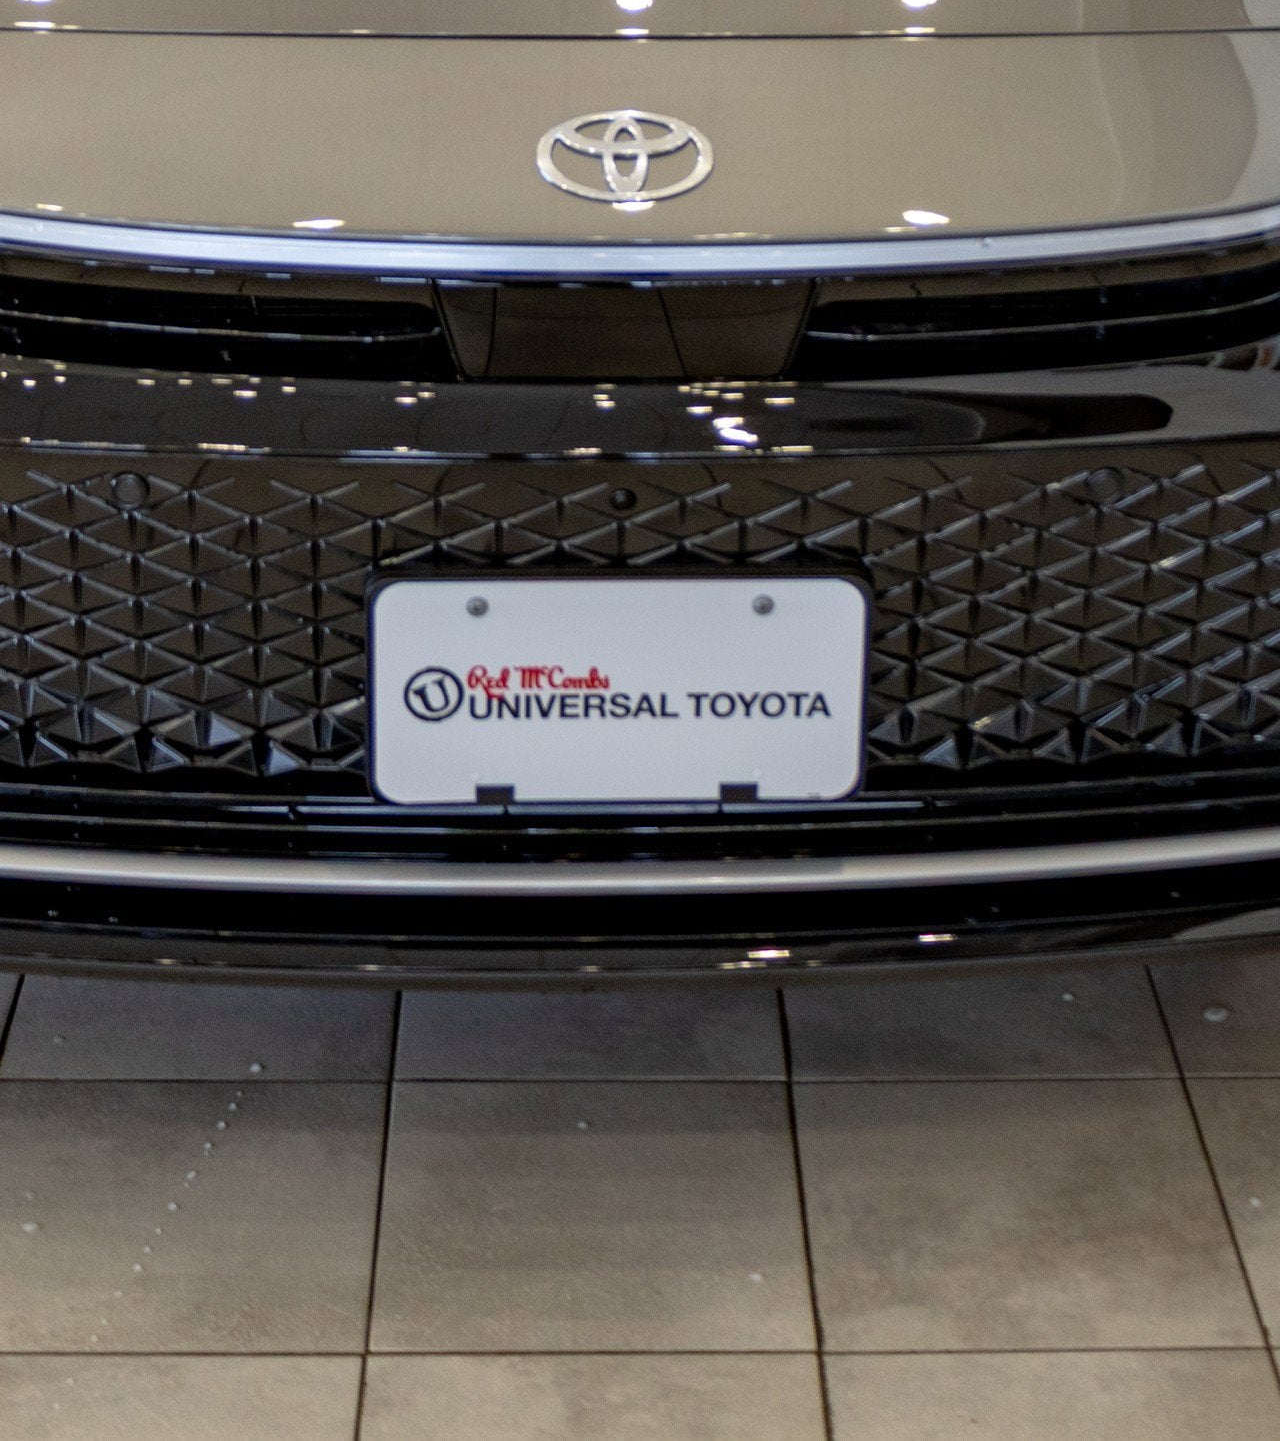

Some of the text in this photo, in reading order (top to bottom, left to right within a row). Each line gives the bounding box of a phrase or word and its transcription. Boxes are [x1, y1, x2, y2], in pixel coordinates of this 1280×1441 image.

[466, 664, 510, 701] Red
[468, 691, 832, 720] UNIVERSAL TOYOTA
